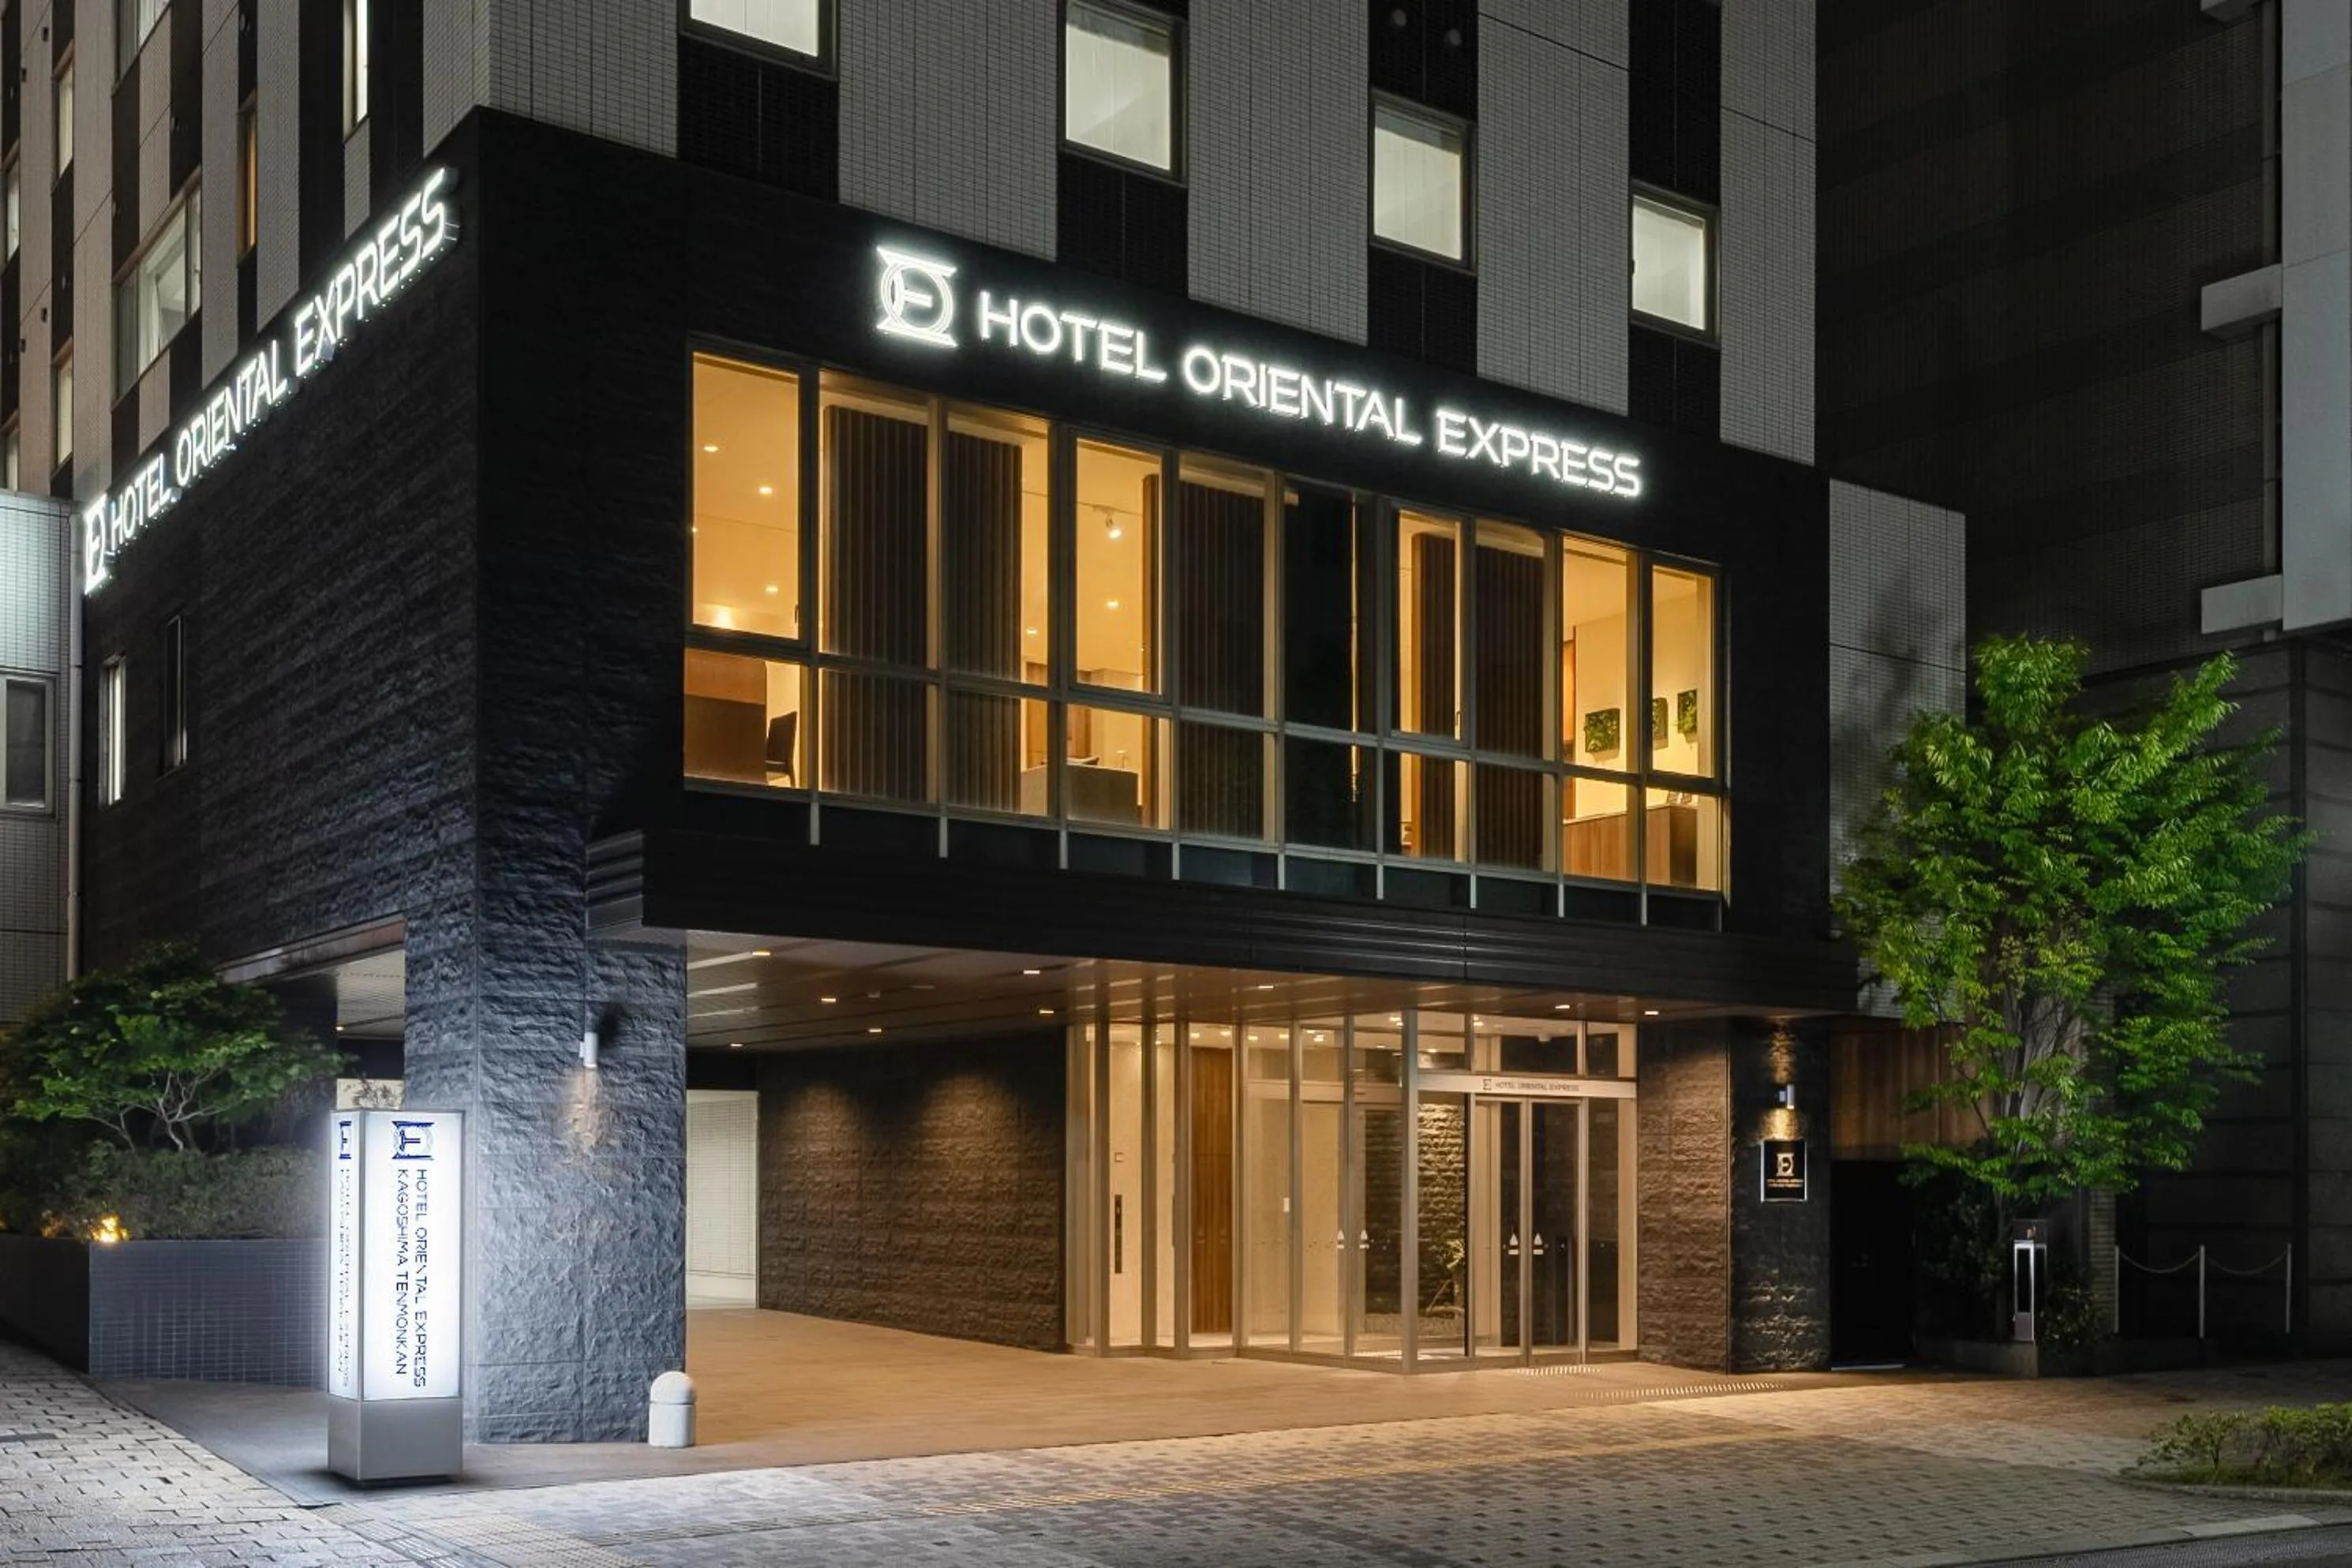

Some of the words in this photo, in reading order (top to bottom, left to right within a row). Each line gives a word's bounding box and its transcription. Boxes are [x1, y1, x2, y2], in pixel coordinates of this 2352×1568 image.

[110, 452, 172, 552] HOTEL
[175, 339, 288, 488] ORIENTAL
[293, 167, 447, 376] EXPRESS
[979, 290, 1167, 382] HOTEL
[1183, 346, 1422, 446] ORIENTAL
[1435, 406, 1642, 498] EXPRESS
[395, 1169, 409, 1267] KAGOSHIMA
[415, 1169, 428, 1222] HOTEL
[395, 1270, 409, 1375] TENMONKAN
[413, 1310, 428, 1388] EXPRESS
